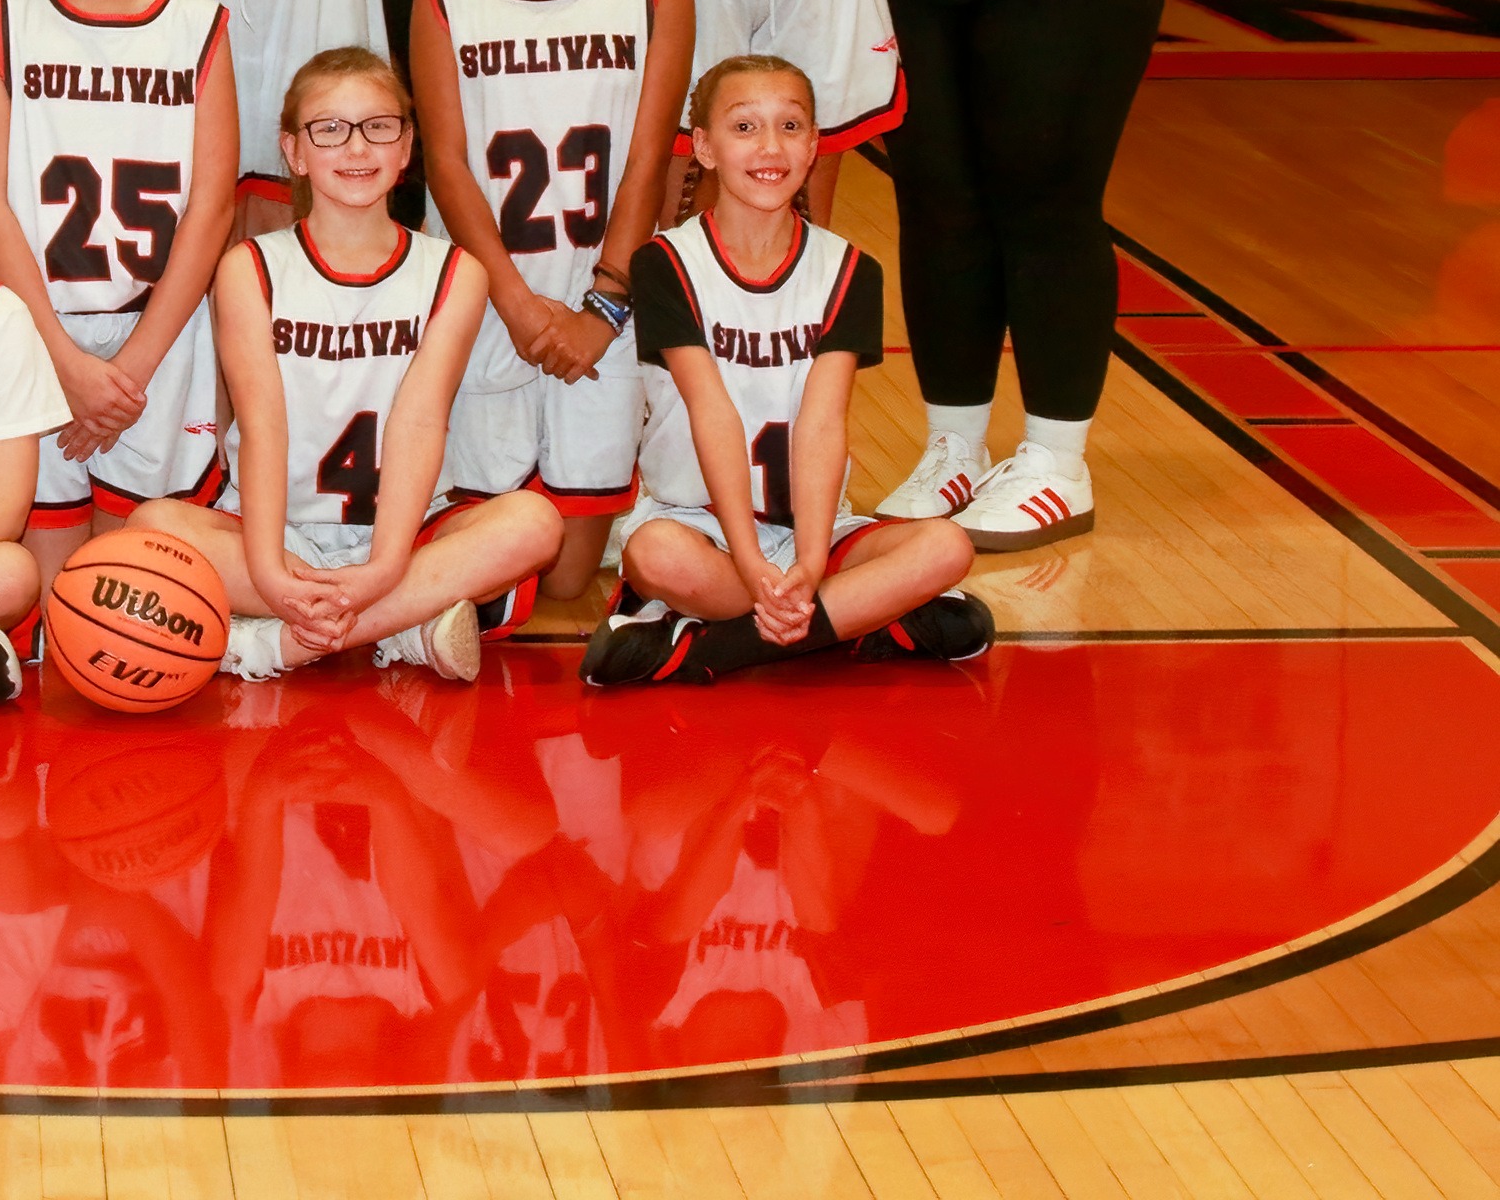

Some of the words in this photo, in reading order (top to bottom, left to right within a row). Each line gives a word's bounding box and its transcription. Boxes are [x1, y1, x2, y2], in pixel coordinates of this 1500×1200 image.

[23, 63, 195, 106] SULLIVAN
[459, 33, 637, 79] SULLIVAN
[39, 154, 184, 286] 25
[487, 123, 612, 255] 23
[316, 409, 381, 526] 4
[751, 421, 795, 530] 1
[91, 574, 204, 647] Wilson
[88, 649, 166, 689] EVO
